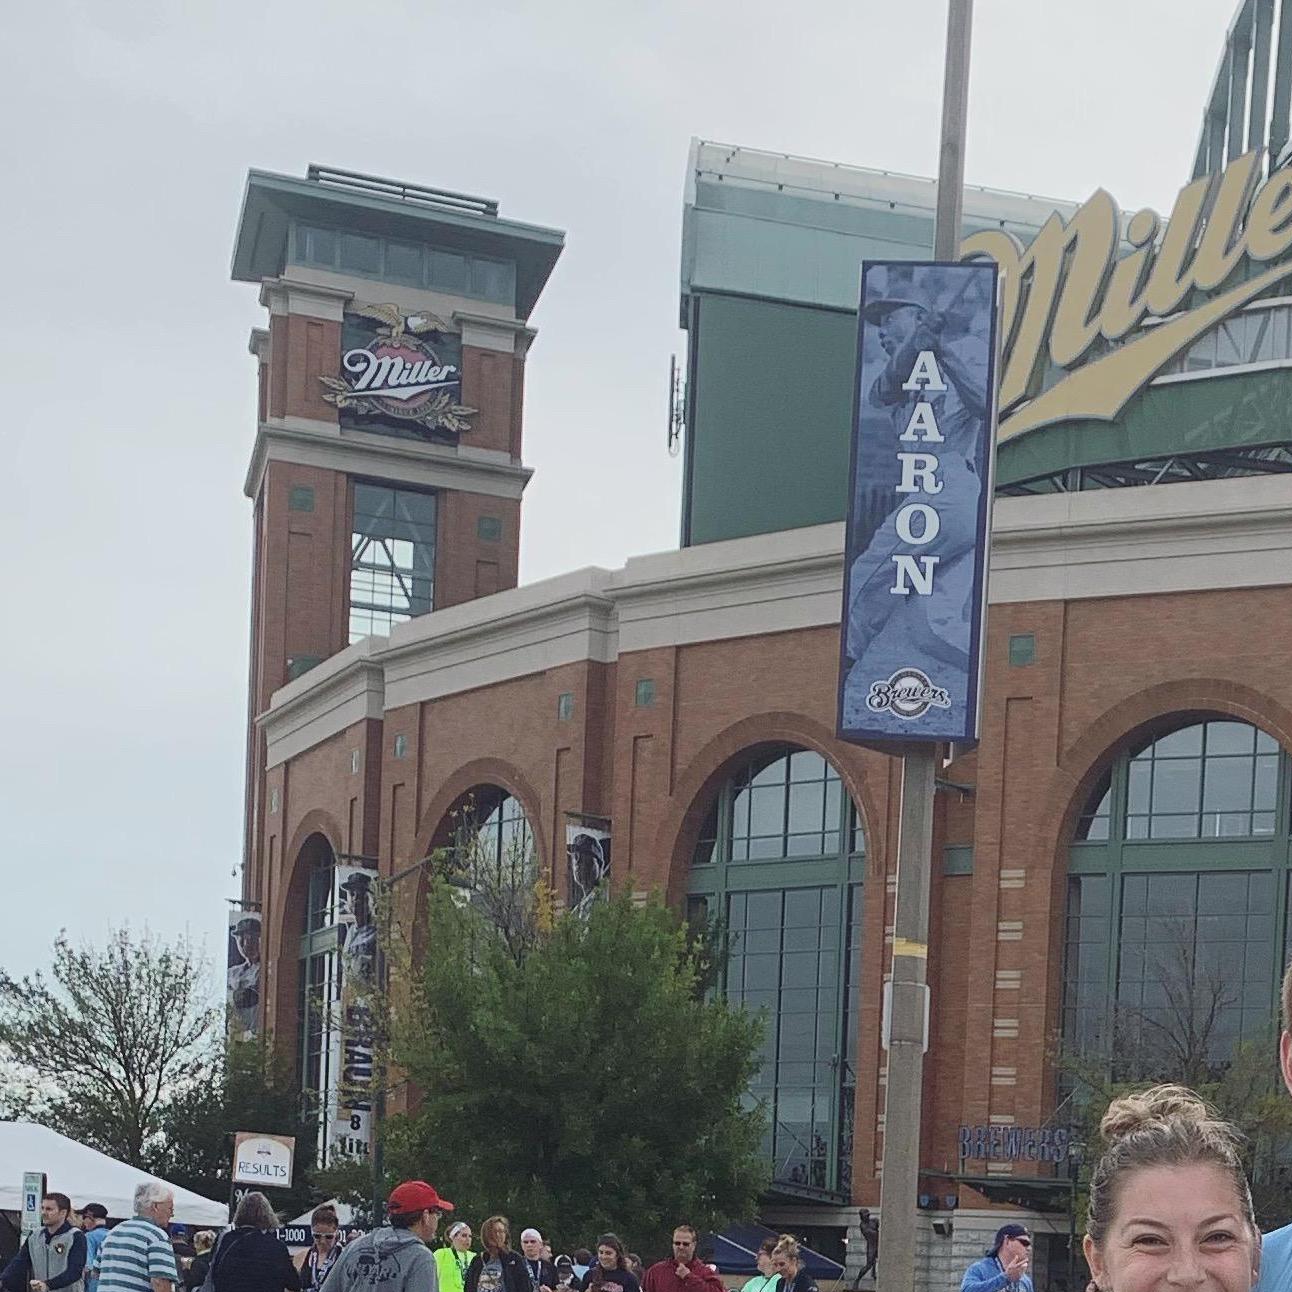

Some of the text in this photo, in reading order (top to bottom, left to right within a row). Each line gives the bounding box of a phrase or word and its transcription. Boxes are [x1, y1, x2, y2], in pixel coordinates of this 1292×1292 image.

[343, 349, 457, 391] Miller
[890, 350, 948, 596] AARON
[867, 682, 950, 711] Brewers
[350, 1114, 362, 1130] 8
[959, 1125, 1068, 1161] BREWERS
[238, 1161, 287, 1177] RESULTS
